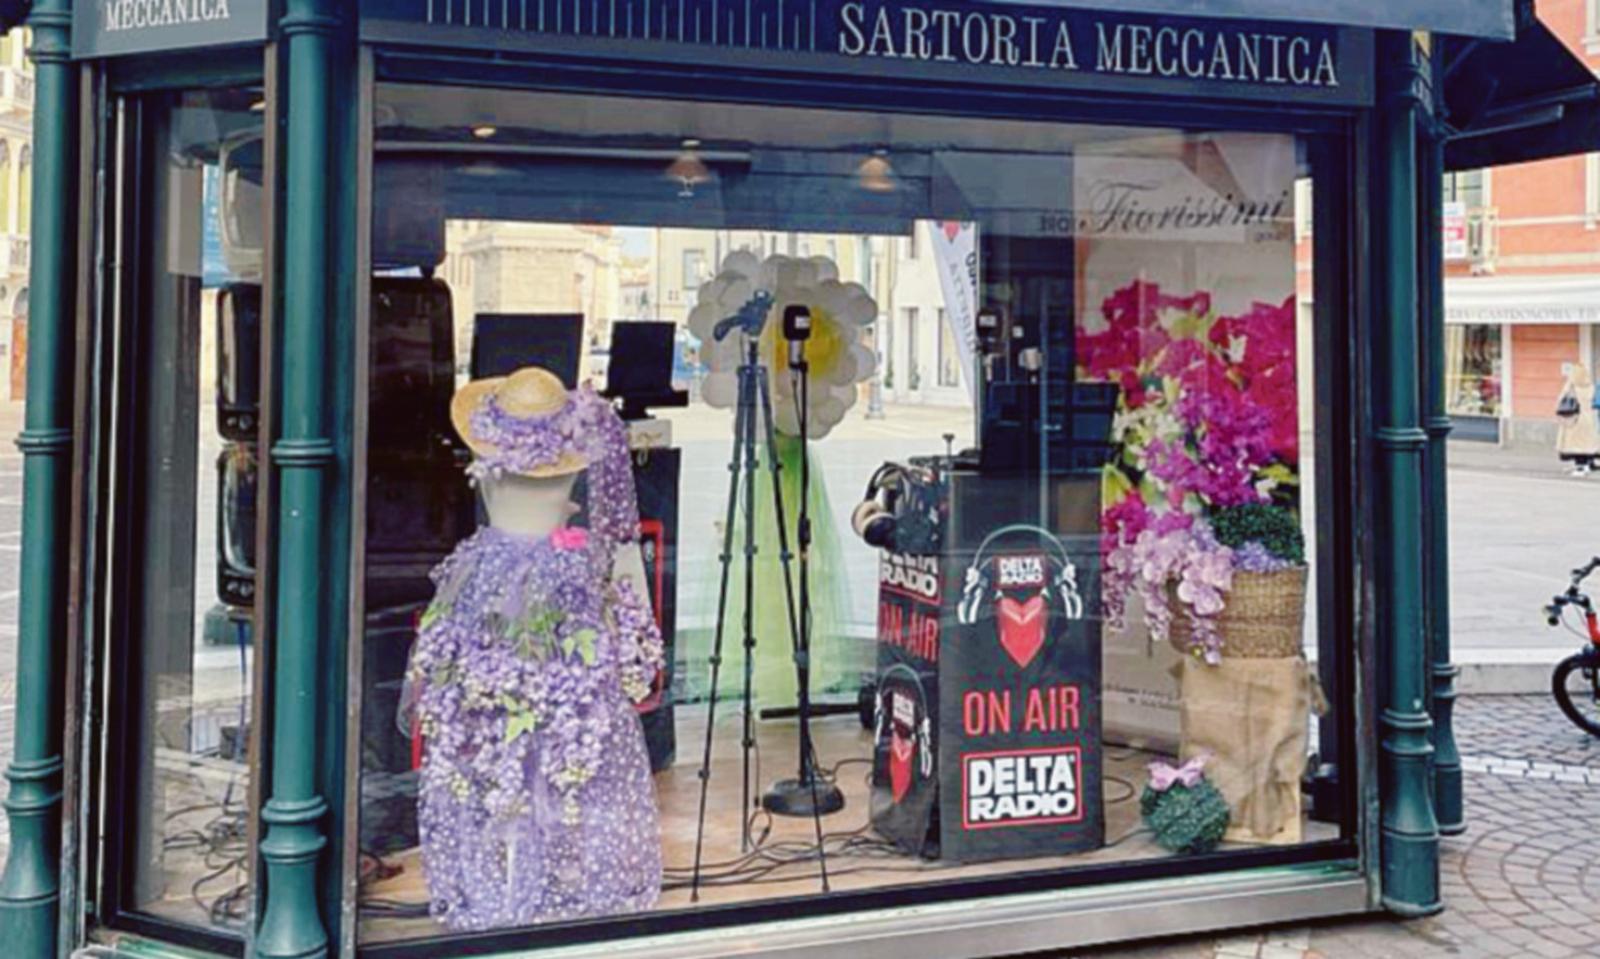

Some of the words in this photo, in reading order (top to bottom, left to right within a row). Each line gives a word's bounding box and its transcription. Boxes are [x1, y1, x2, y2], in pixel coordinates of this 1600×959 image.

[105, 0, 231, 31] MECCANICA
[838, 2, 1079, 70] SARTORIA
[1095, 22, 1339, 87] MECCANICA
[1082, 180, 1288, 233] Fiorissimi
[880, 561, 938, 597] RADIO
[906, 610, 939, 663] AIR
[964, 689, 1010, 736] ON
[1024, 686, 1080, 733] AIR
[969, 754, 1076, 797] DELTA
[969, 793, 1076, 821] RADIO
